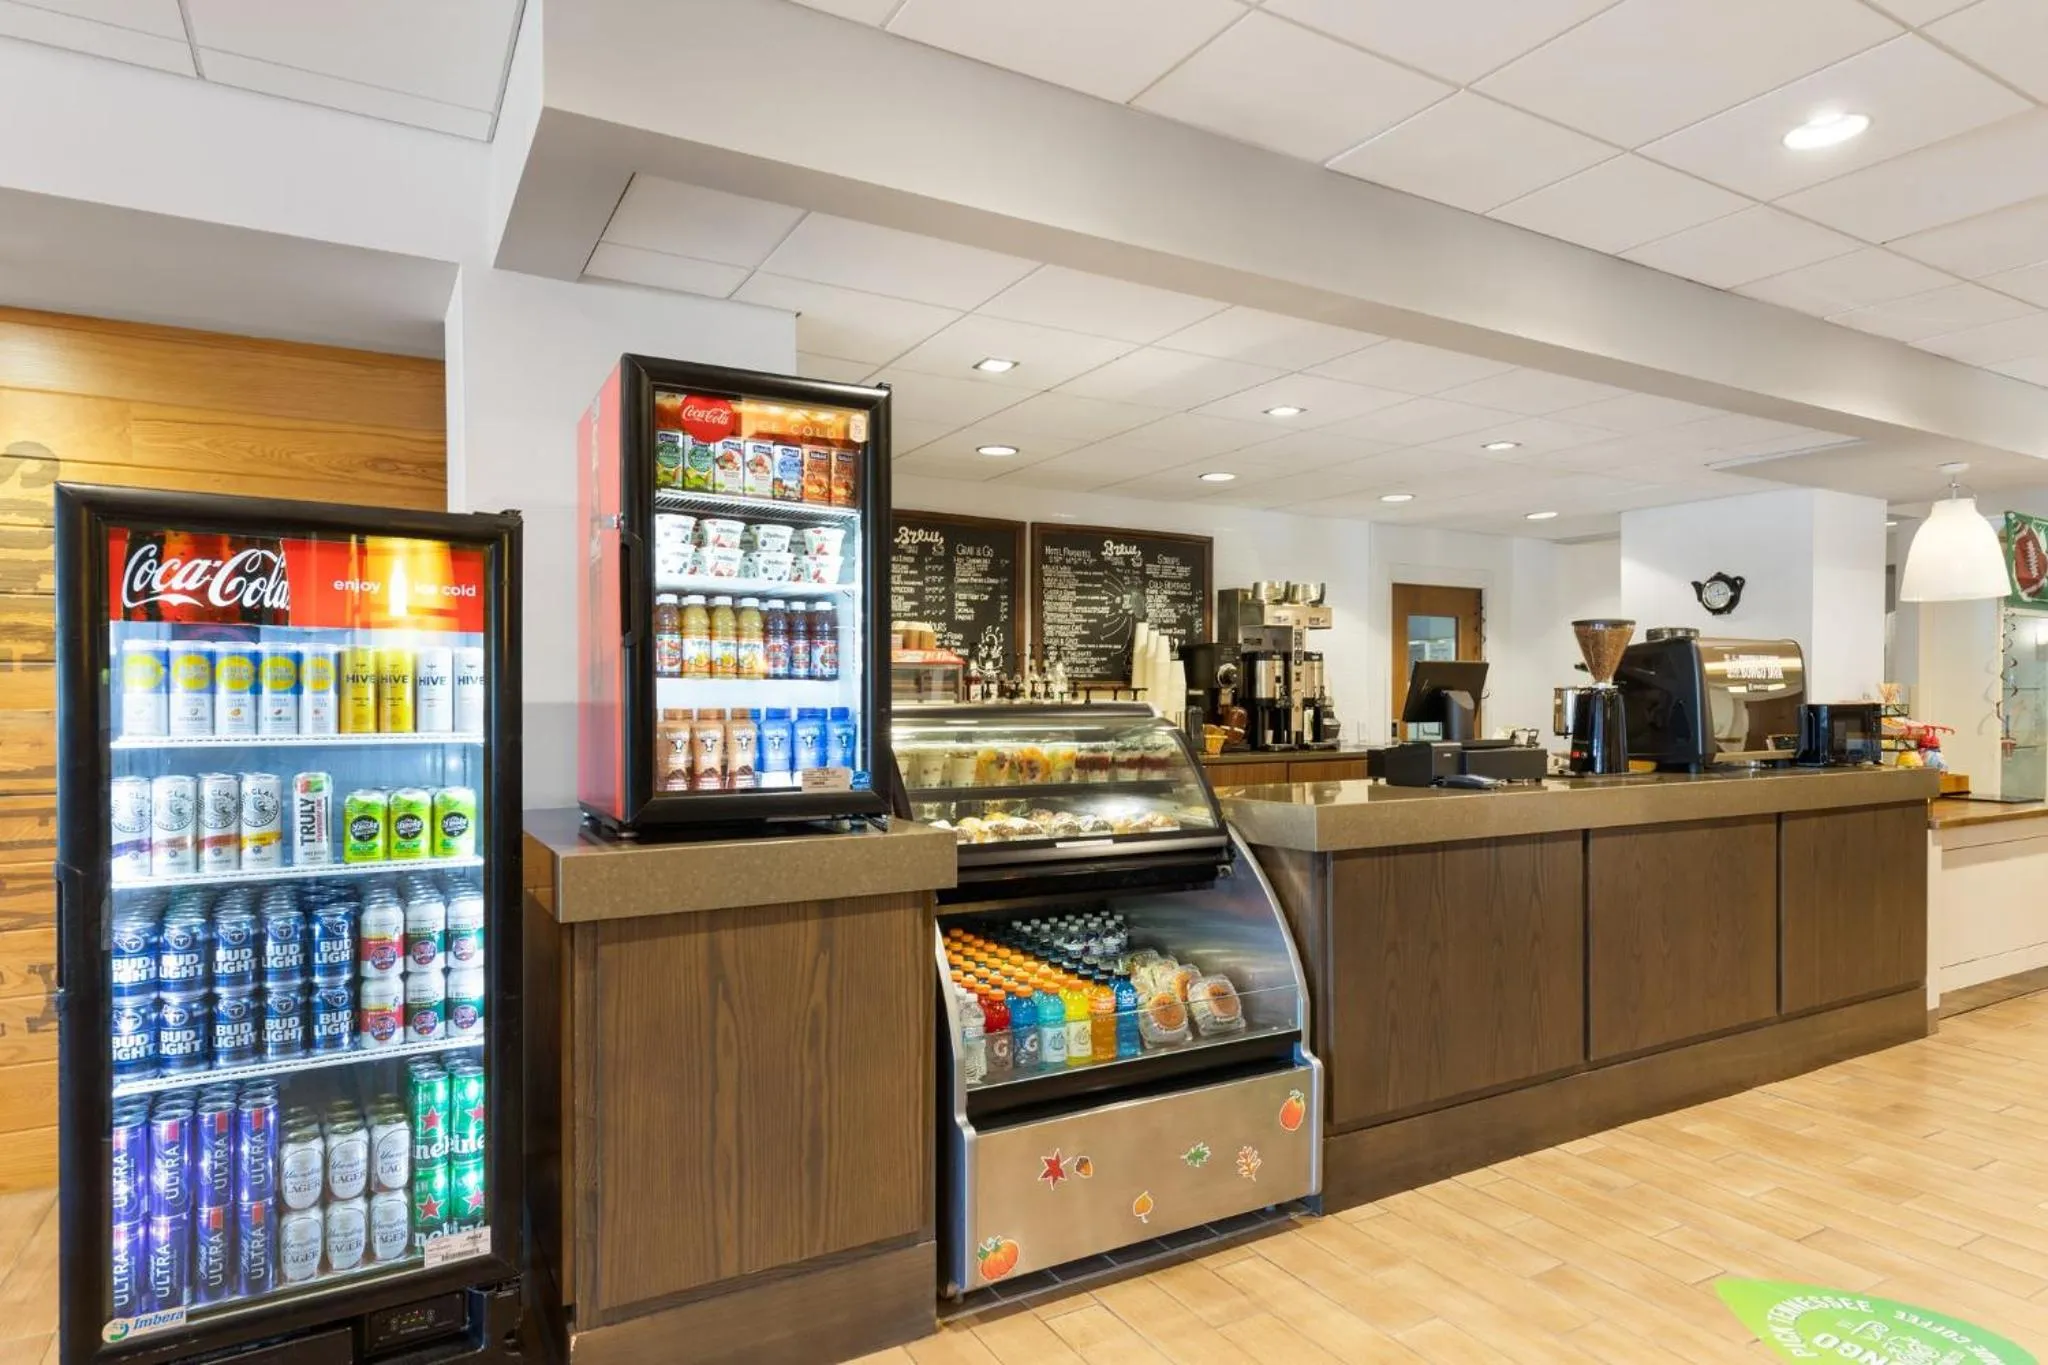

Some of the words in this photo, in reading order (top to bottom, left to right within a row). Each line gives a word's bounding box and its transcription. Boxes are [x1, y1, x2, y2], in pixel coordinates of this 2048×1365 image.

[682, 405, 731, 425] Coca-Cola
[122, 544, 290, 610] Coca-Cola
[333, 579, 381, 594] enjoy
[441, 583, 476, 597] cold
[345, 673, 377, 684] HIVE
[381, 674, 409, 684] HIVE
[418, 676, 448, 686] HIVE
[300, 797, 316, 846] TRULY
[266, 943, 300, 956] BUD
[320, 938, 352, 951] BUD
[162, 953, 199, 966] BUD
[215, 948, 252, 961] BUD
[112, 957, 150, 970] BUD
[265, 1017, 299, 1030] BUD
[320, 1009, 352, 1023] BUD
[161, 1029, 196, 1043] BUD
[215, 1023, 252, 1036] BUD
[112, 1043, 156, 1060] IGHT
[994, 1039, 1008, 1057] G
[215, 1136, 229, 1190] ULTRA
[252, 1132, 265, 1185] ULTRA
[113, 1152, 128, 1208] ULTRA
[165, 1145, 180, 1200] ULTRA
[209, 1231, 224, 1287] ULTRA
[251, 1226, 265, 1280] ULTRA
[113, 1250, 129, 1308] ULTRA
[156, 1243, 170, 1298] ULTRA
[1767, 1295, 1874, 1325] TENNESSEE
[133, 1310, 184, 1331] Imbera
